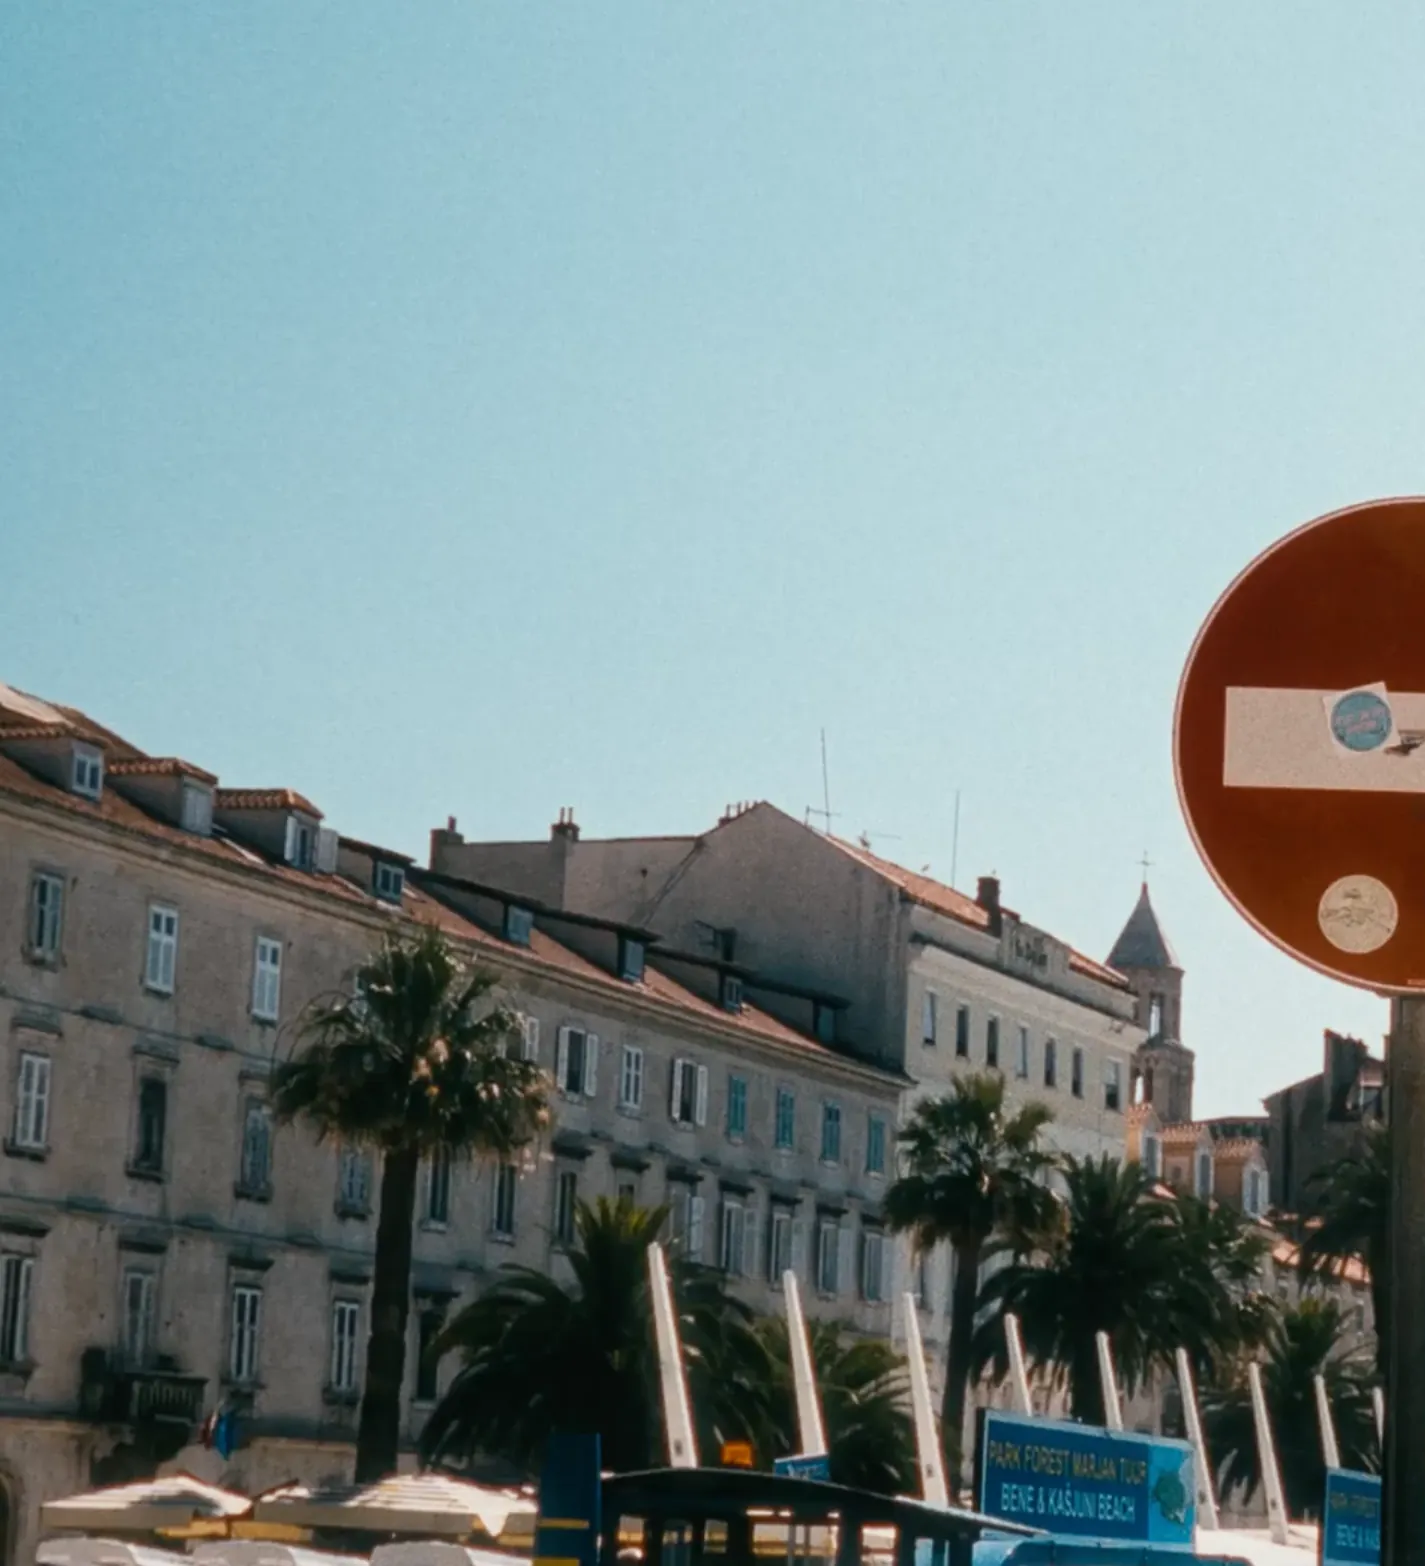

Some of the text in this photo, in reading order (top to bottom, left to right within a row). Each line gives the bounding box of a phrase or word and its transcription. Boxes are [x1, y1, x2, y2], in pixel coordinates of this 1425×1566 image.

[988, 1439, 1147, 1486] PARK FOREST MARJAN TOUR
[1001, 1482, 1035, 1513] BENE
[1037, 1486, 1045, 1515] &
[1098, 1493, 1136, 1524] BEACH
